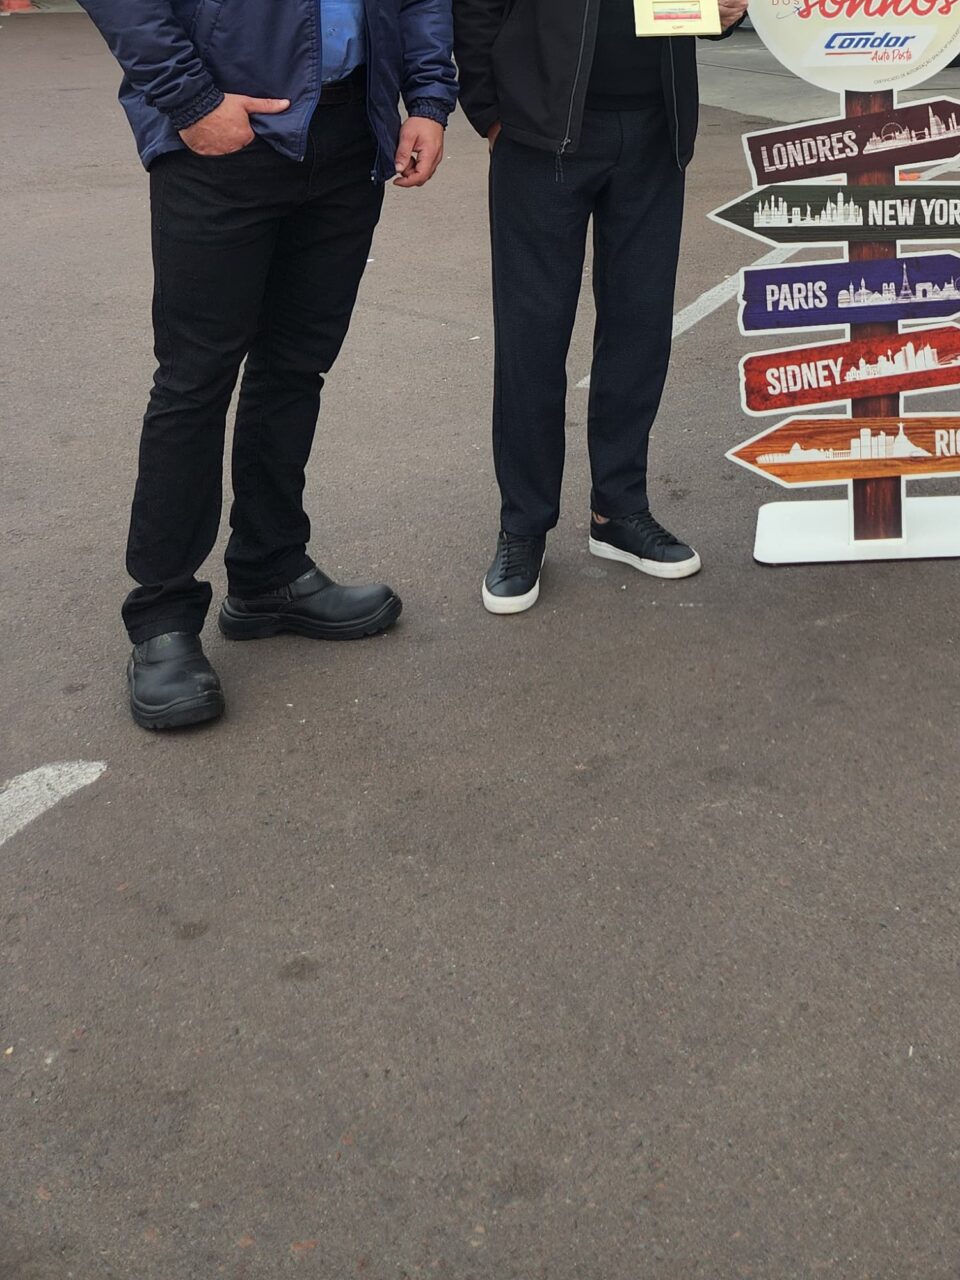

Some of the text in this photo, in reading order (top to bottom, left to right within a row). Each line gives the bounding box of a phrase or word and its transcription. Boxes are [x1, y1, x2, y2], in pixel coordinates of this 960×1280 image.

[824, 32, 916, 49] Condor
[871, 48, 913, 63] Auto Posto
[761, 130, 860, 173] LONDRES
[868, 199, 918, 226] NEW
[765, 281, 829, 312] PARIS
[766, 357, 844, 396] SIDNEY
